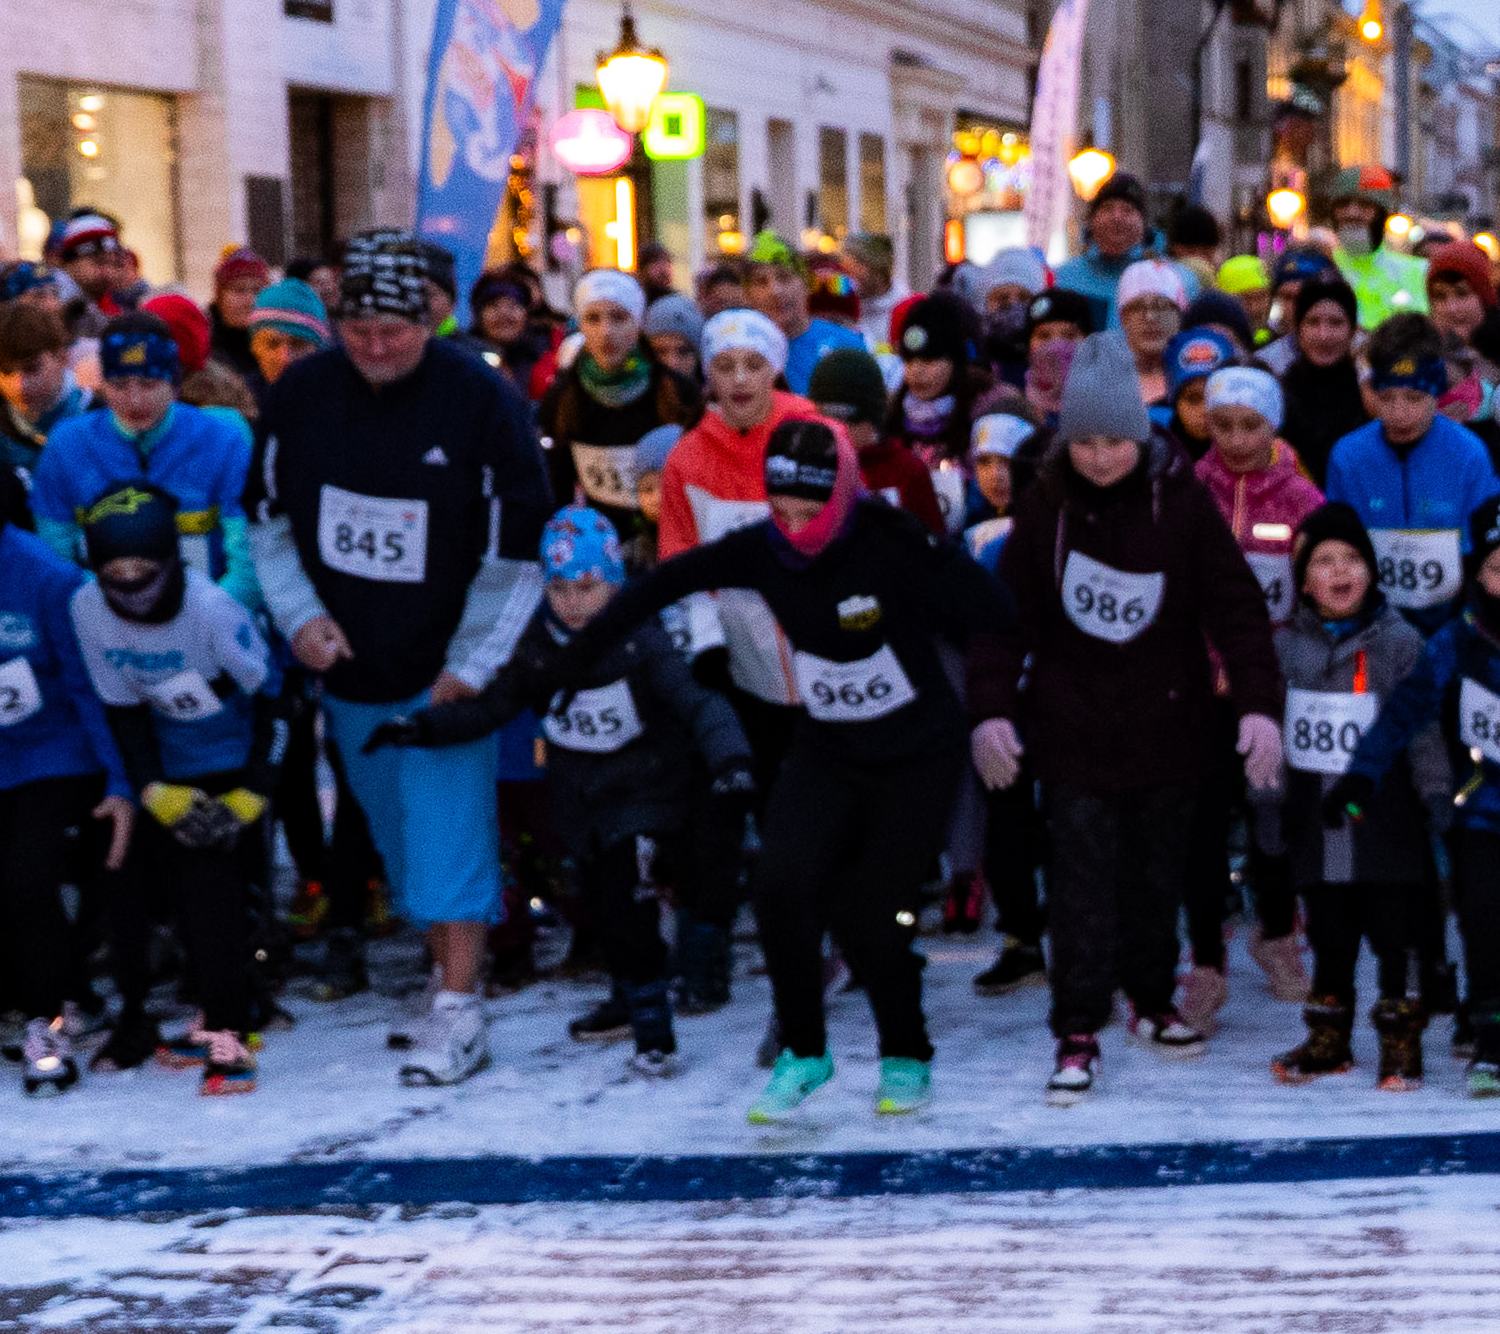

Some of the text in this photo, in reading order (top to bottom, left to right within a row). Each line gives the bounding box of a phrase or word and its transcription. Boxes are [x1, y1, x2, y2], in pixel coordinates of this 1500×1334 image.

[335, 523, 405, 563] 845
[1377, 556, 1444, 590] 889
[1074, 583, 1144, 624] 986
[811, 673, 892, 707] 966
[1293, 718, 1361, 754] 880
